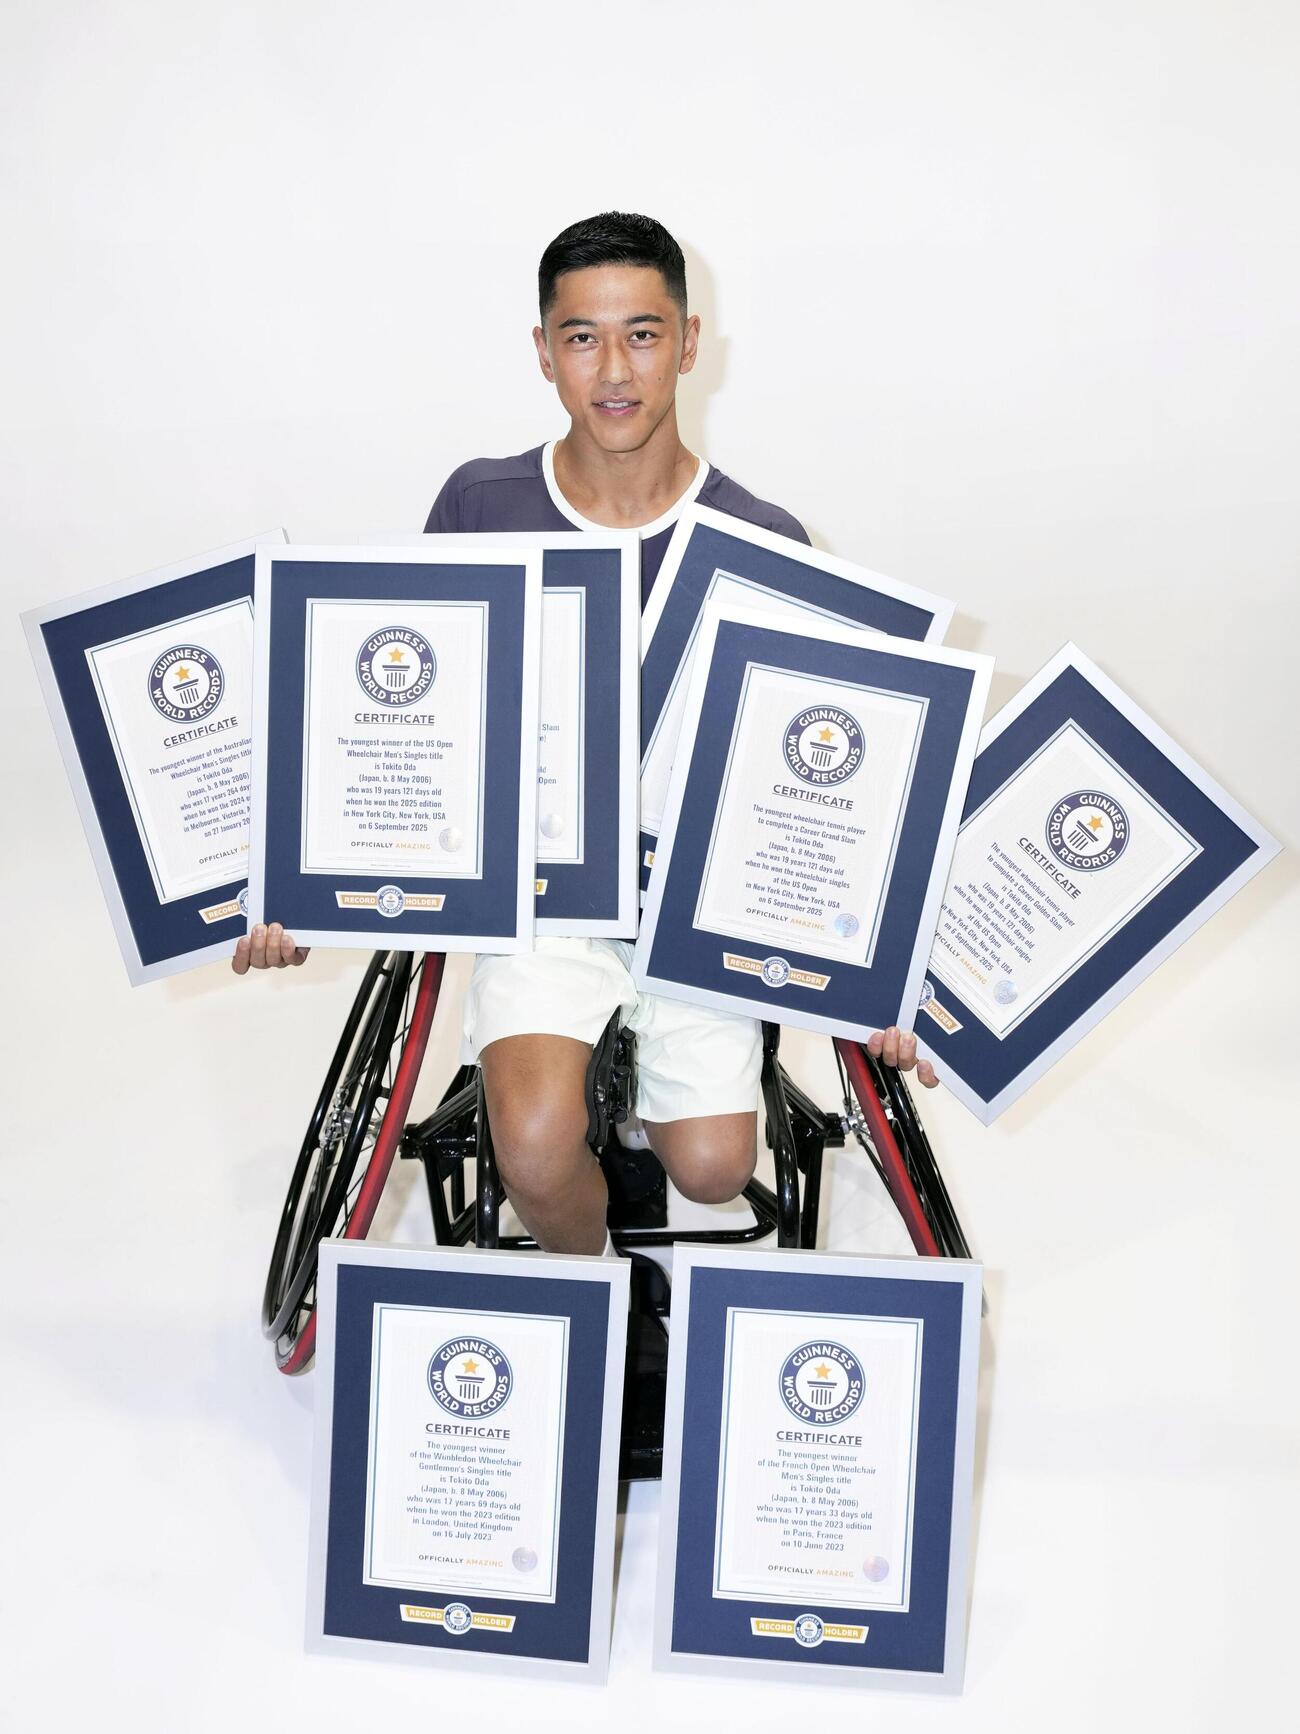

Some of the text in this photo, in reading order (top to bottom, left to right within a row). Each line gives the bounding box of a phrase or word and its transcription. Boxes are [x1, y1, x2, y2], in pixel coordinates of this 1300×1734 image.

[368, 631, 426, 653] GUINNESS
[154, 648, 208, 679] GUINNESS
[360, 661, 432, 703] WORLD RECORDS
[152, 669, 220, 720] WORLD RECORDS
[354, 713, 435, 724] CERTIFICATE
[799, 709, 857, 737] GUINNESS
[163, 716, 238, 747] CERTIFICATE
[337, 737, 349, 745] The
[350, 739, 380, 747] youngest
[404, 739, 412, 747] of
[413, 739, 424, 747] the
[425, 739, 435, 748] US
[436, 740, 453, 749] Open
[160, 758, 186, 773] youngest
[186, 753, 205, 764] winner
[206, 749, 212, 757] of
[212, 747, 223, 755] the
[346, 749, 443, 761] Wheelchair Men's Singles title
[788, 734, 860, 782] WORLD RECORDS
[374, 762, 417, 771] is Tokito Oda
[346, 786, 360, 794] who
[374, 786, 382, 794] 19
[383, 788, 401, 796] years
[403, 787, 413, 795] 121
[415, 787, 430, 797] days
[431, 788, 442, 796] old
[773, 784, 854, 810] CERTIFICATE
[753, 804, 866, 835] The youngest wheelchair tennis player
[1079, 795, 1124, 839] GUINNESS
[368, 822, 373, 830] 6
[374, 822, 409, 832] September
[411, 823, 428, 832] 2025
[765, 820, 794, 831] complete
[799, 825, 821, 837] Career
[821, 831, 840, 841] Grand
[840, 835, 856, 845] Slam
[1050, 803, 1116, 867] WORLD RECORDS
[785, 834, 824, 849] is Tokito Oda
[199, 848, 238, 865] OFFICIALLY
[1019, 837, 1081, 899] CERTIFICATE
[992, 861, 1015, 884] complete
[1017, 884, 1034, 902] Career
[1033, 900, 1051, 919] Golden
[1049, 916, 1063, 931] Slam
[999, 852, 1022, 874] youngest
[1020, 872, 1046, 898] wheelchair
[1044, 896, 1061, 913] tennis
[1057, 911, 1075, 927] player
[1006, 889, 1022, 907] Tokito
[208, 903, 238, 918] RECORD
[767, 897, 772, 905] 6
[773, 898, 806, 912] September
[806, 906, 823, 917] 2025
[746, 907, 825, 930] OFFICIALLY AMAZING
[730, 958, 761, 970] RECORD
[790, 972, 821, 984] HOLDER
[958, 957, 987, 985] AMAZING
[926, 1001, 952, 1027] HOLDER
[440, 1342, 502, 1366] GUINNESS
[792, 1346, 854, 1370] GUINNESS
[432, 1370, 508, 1416] WORLD RECORDS
[784, 1376, 860, 1422] WORLD RECORDS
[425, 1423, 510, 1439] CERTIFICATE
[776, 1430, 863, 1446] CERTIFICATE
[427, 1440, 506, 1455] The youngest winner
[778, 1449, 857, 1462] The youngest winner
[409, 1450, 417, 1458] of
[433, 1452, 476, 1463] Wimbledon
[478, 1456, 522, 1467] Wheelchair
[757, 1459, 876, 1475] of the French Open Wheelchair
[419, 1462, 512, 1477] Gentlemen's Singles title
[781, 1471, 852, 1484] Men's Singles title
[449, 1475, 473, 1485] Tokito
[474, 1477, 490, 1486] Oda
[800, 1484, 824, 1494] Tokito
[825, 1486, 841, 1495] Oda
[412, 1517, 513, 1532] in London, United Kingdom
[444, 1530, 453, 1538] 16
[455, 1531, 472, 1541] July
[473, 1532, 492, 1541] 2023
[783, 1528, 843, 1540] in Paris, France
[793, 1540, 802, 1548] 10
[803, 1540, 823, 1550] June
[825, 1542, 844, 1552] 2023
[418, 1554, 503, 1567] OFFICIALLY AMAZING
[767, 1565, 853, 1577] OFFICIALLY AMAZING
[409, 1609, 506, 1625] RECORD HOLDER
[759, 1623, 858, 1636] RECORD HOLDER
